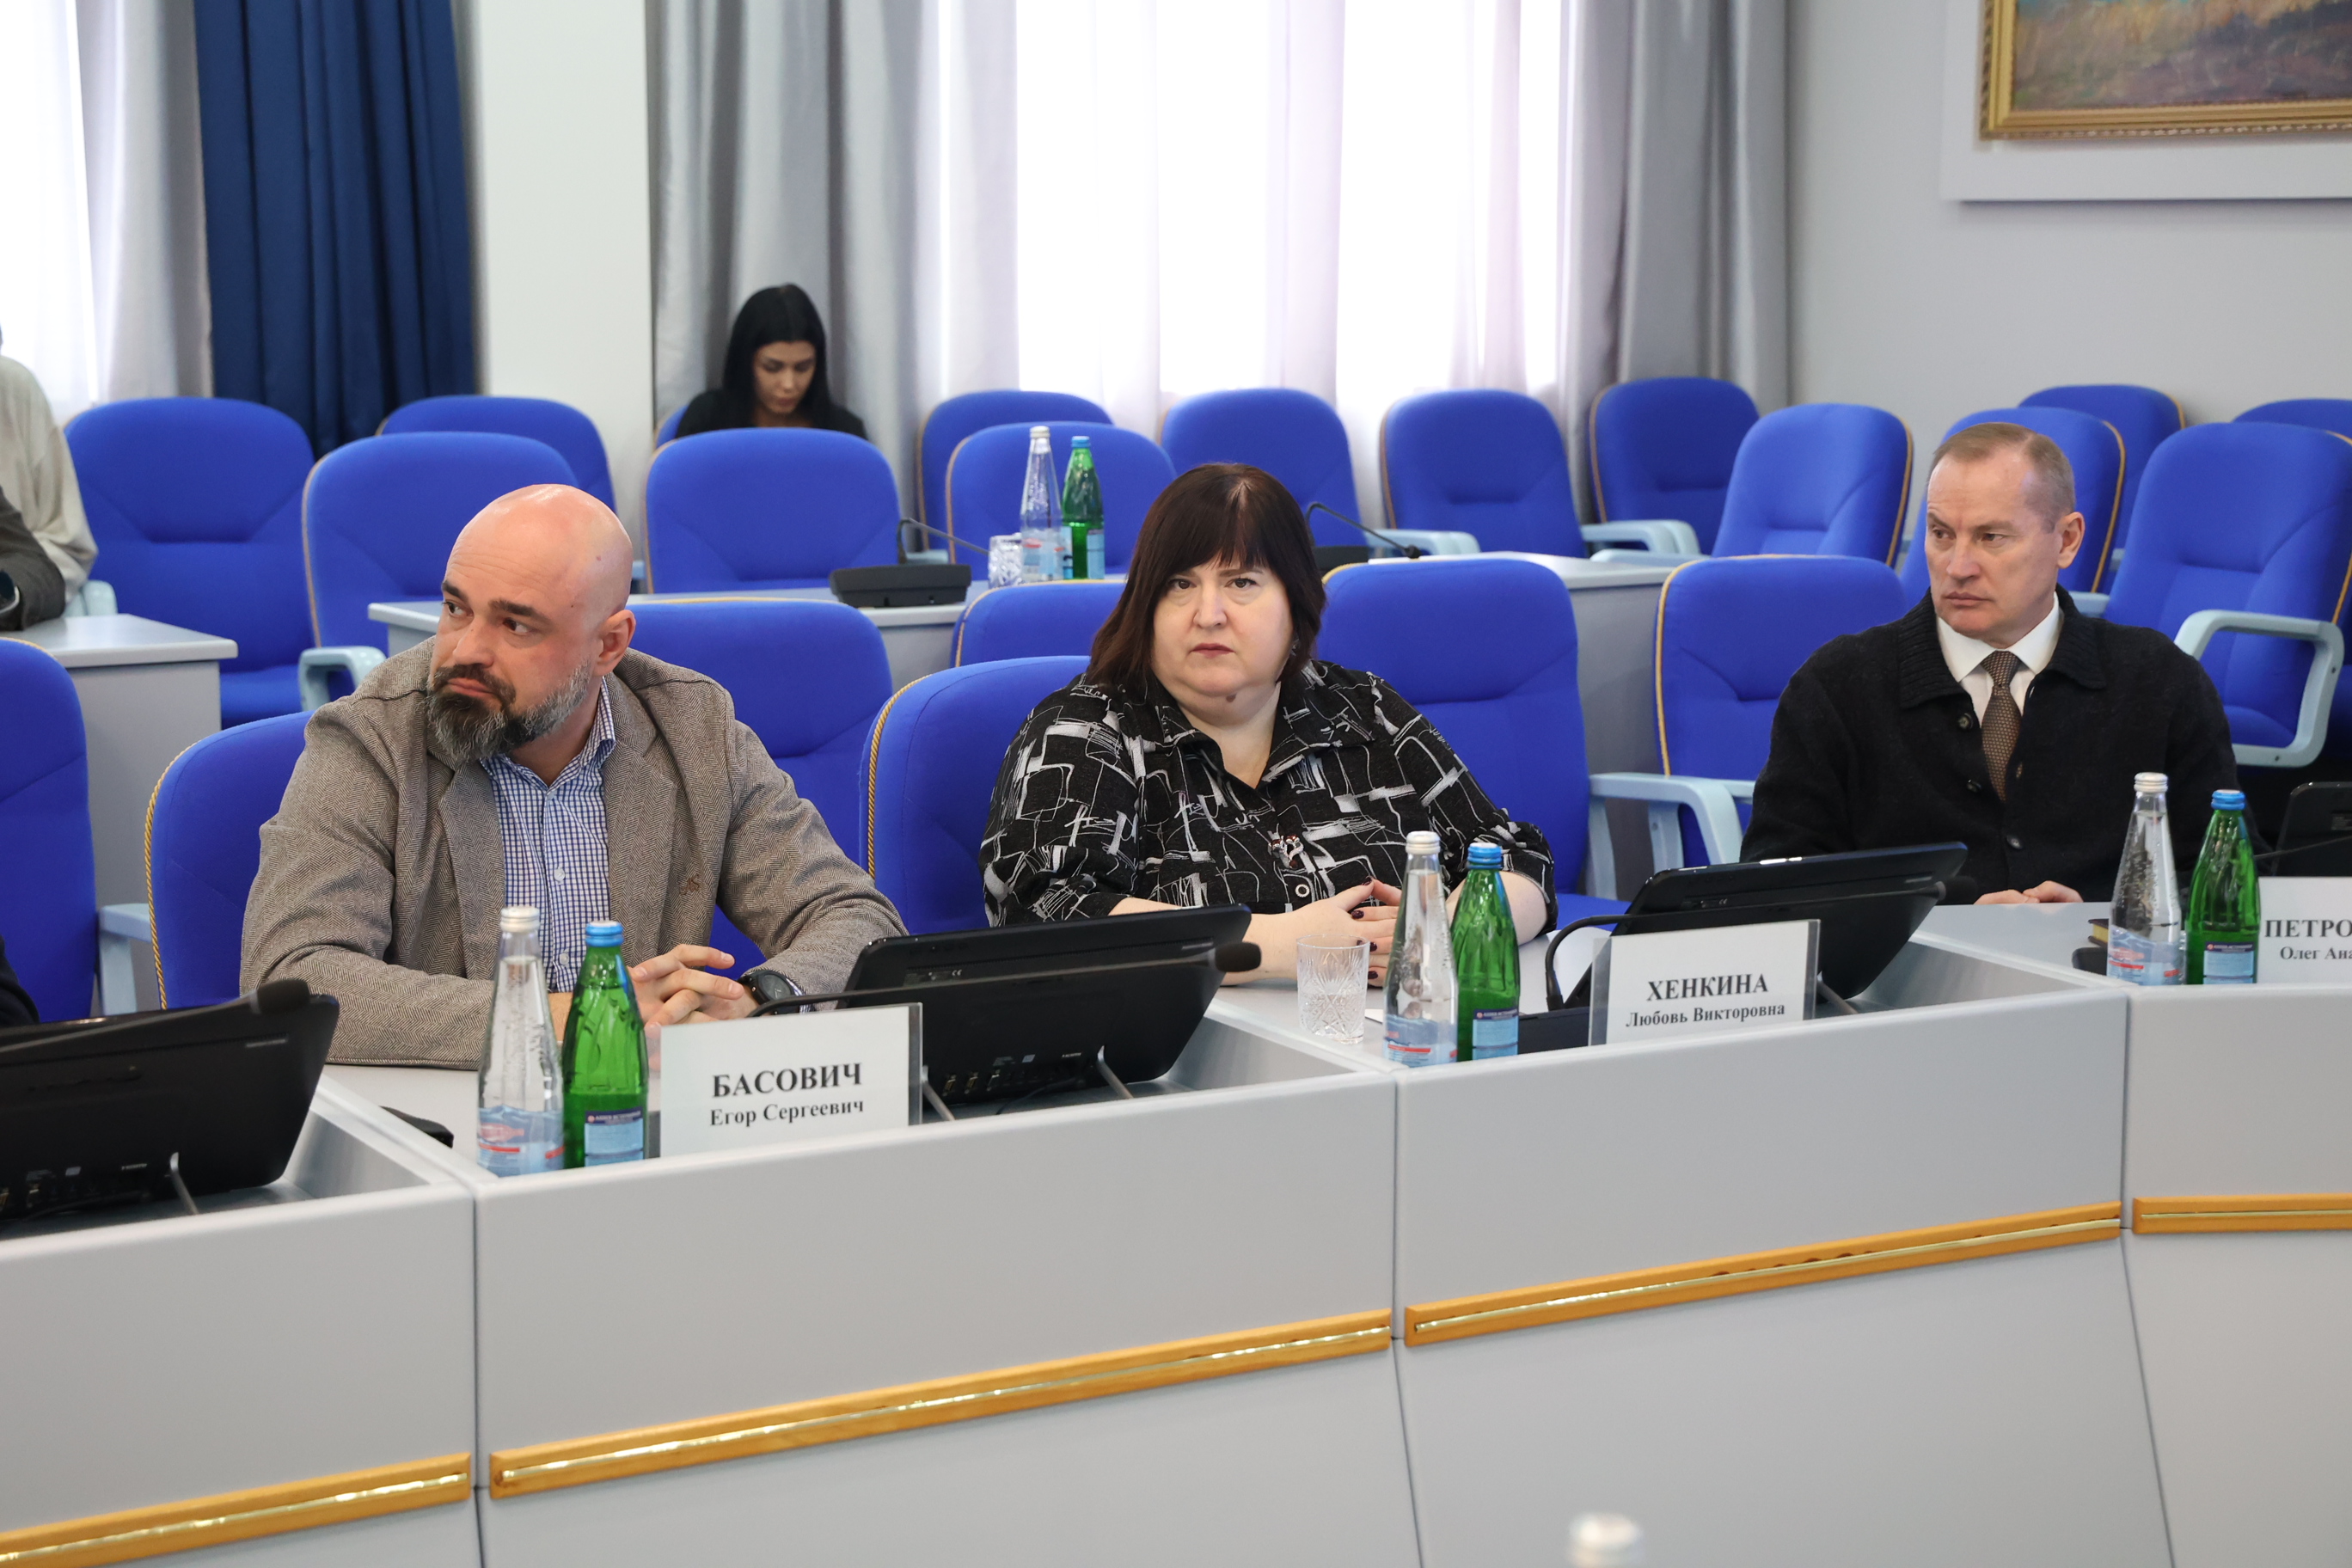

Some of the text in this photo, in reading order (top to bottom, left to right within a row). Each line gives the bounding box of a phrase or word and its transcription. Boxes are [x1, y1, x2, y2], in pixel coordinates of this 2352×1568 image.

[2264, 919, 2352, 938] ПЕТРО
[2280, 946, 2320, 959] Олег
[1646, 973, 1768, 1001] ХЕНКИНА
[1626, 1004, 1785, 1027] Любовь Викторовна
[712, 1063, 862, 1099] БАСОВИЧ
[710, 1100, 864, 1127] Егор Сергеевич
